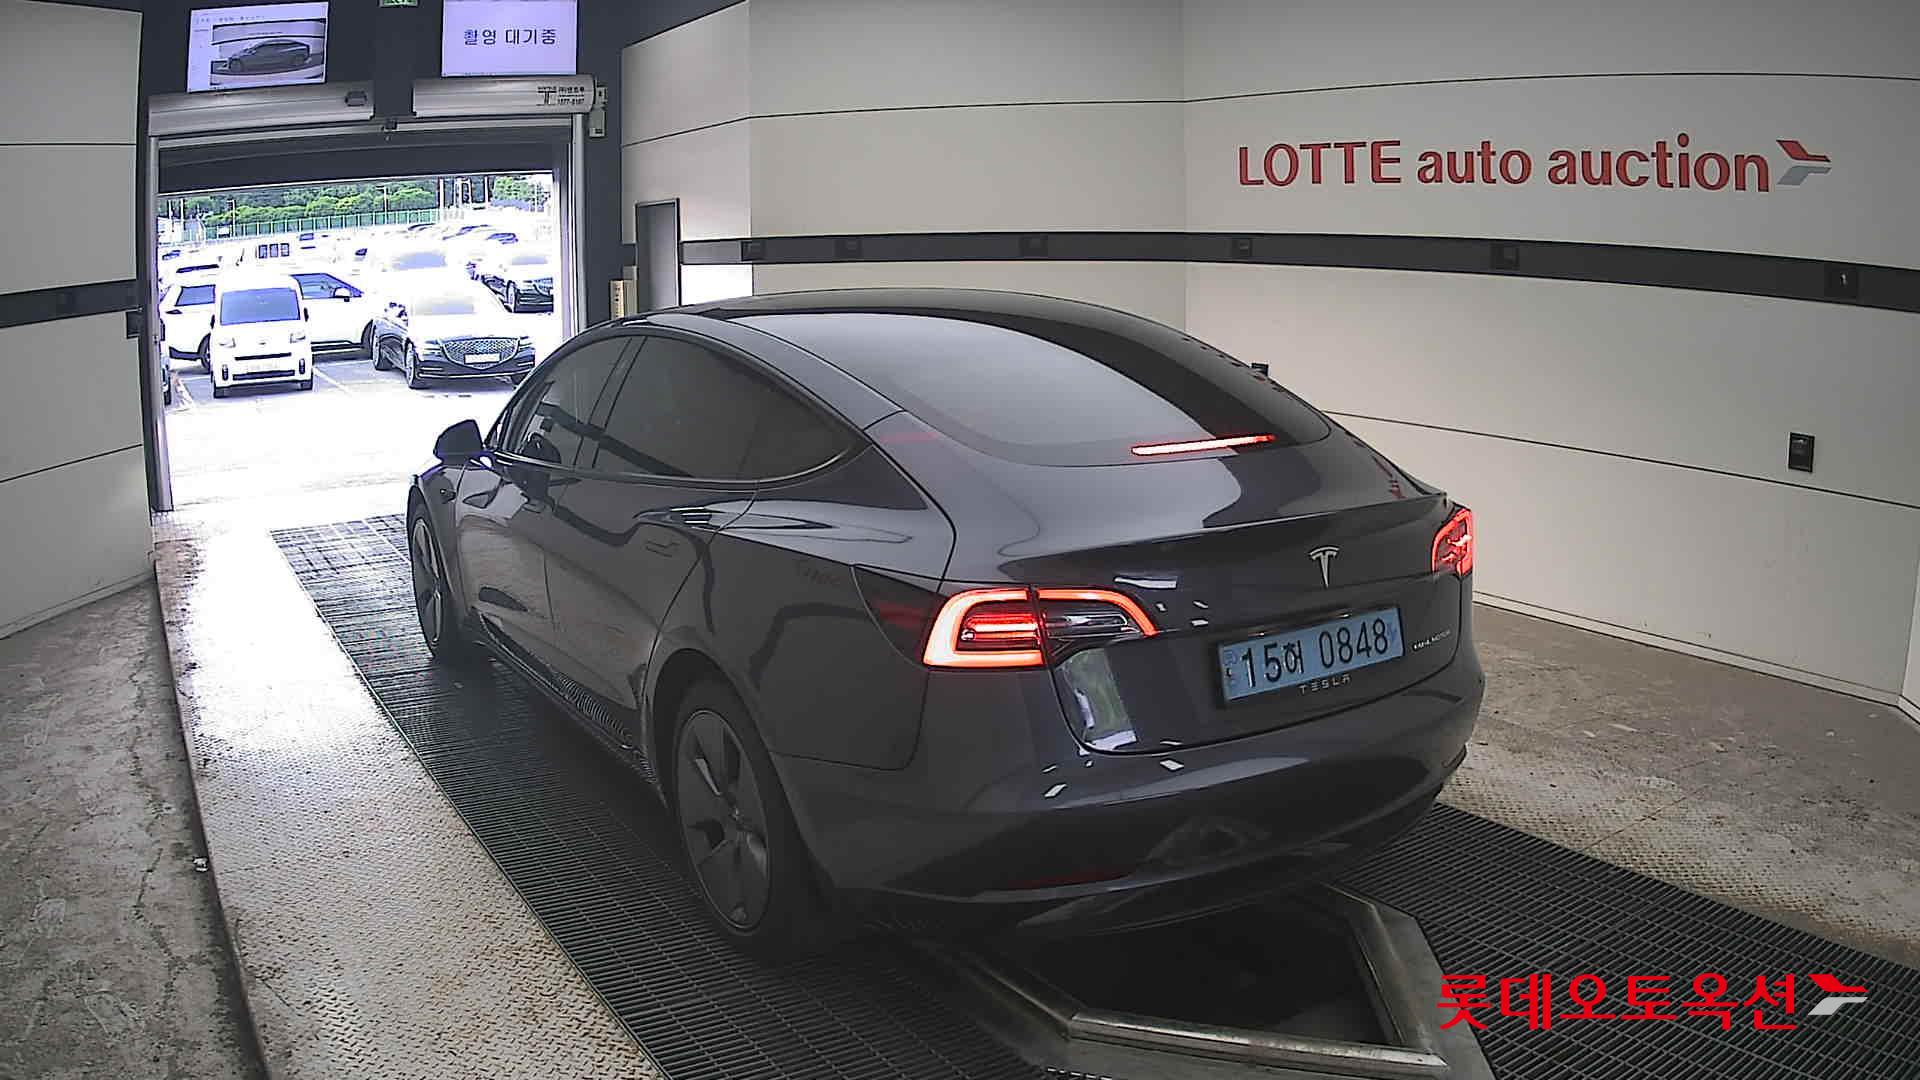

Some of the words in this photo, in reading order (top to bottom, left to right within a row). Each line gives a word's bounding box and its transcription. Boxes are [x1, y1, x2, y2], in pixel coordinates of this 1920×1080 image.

[463, 29, 497, 46] 촬영
[505, 29, 557, 45] 대기중
[1239, 141, 1400, 186] LOTTE
[1418, 140, 1532, 185] auto
[1547, 133, 1770, 192] auction
[1240, 639, 1305, 688] 15허
[1318, 617, 1389, 669] 0848
[1299, 674, 1351, 695] TESLA
